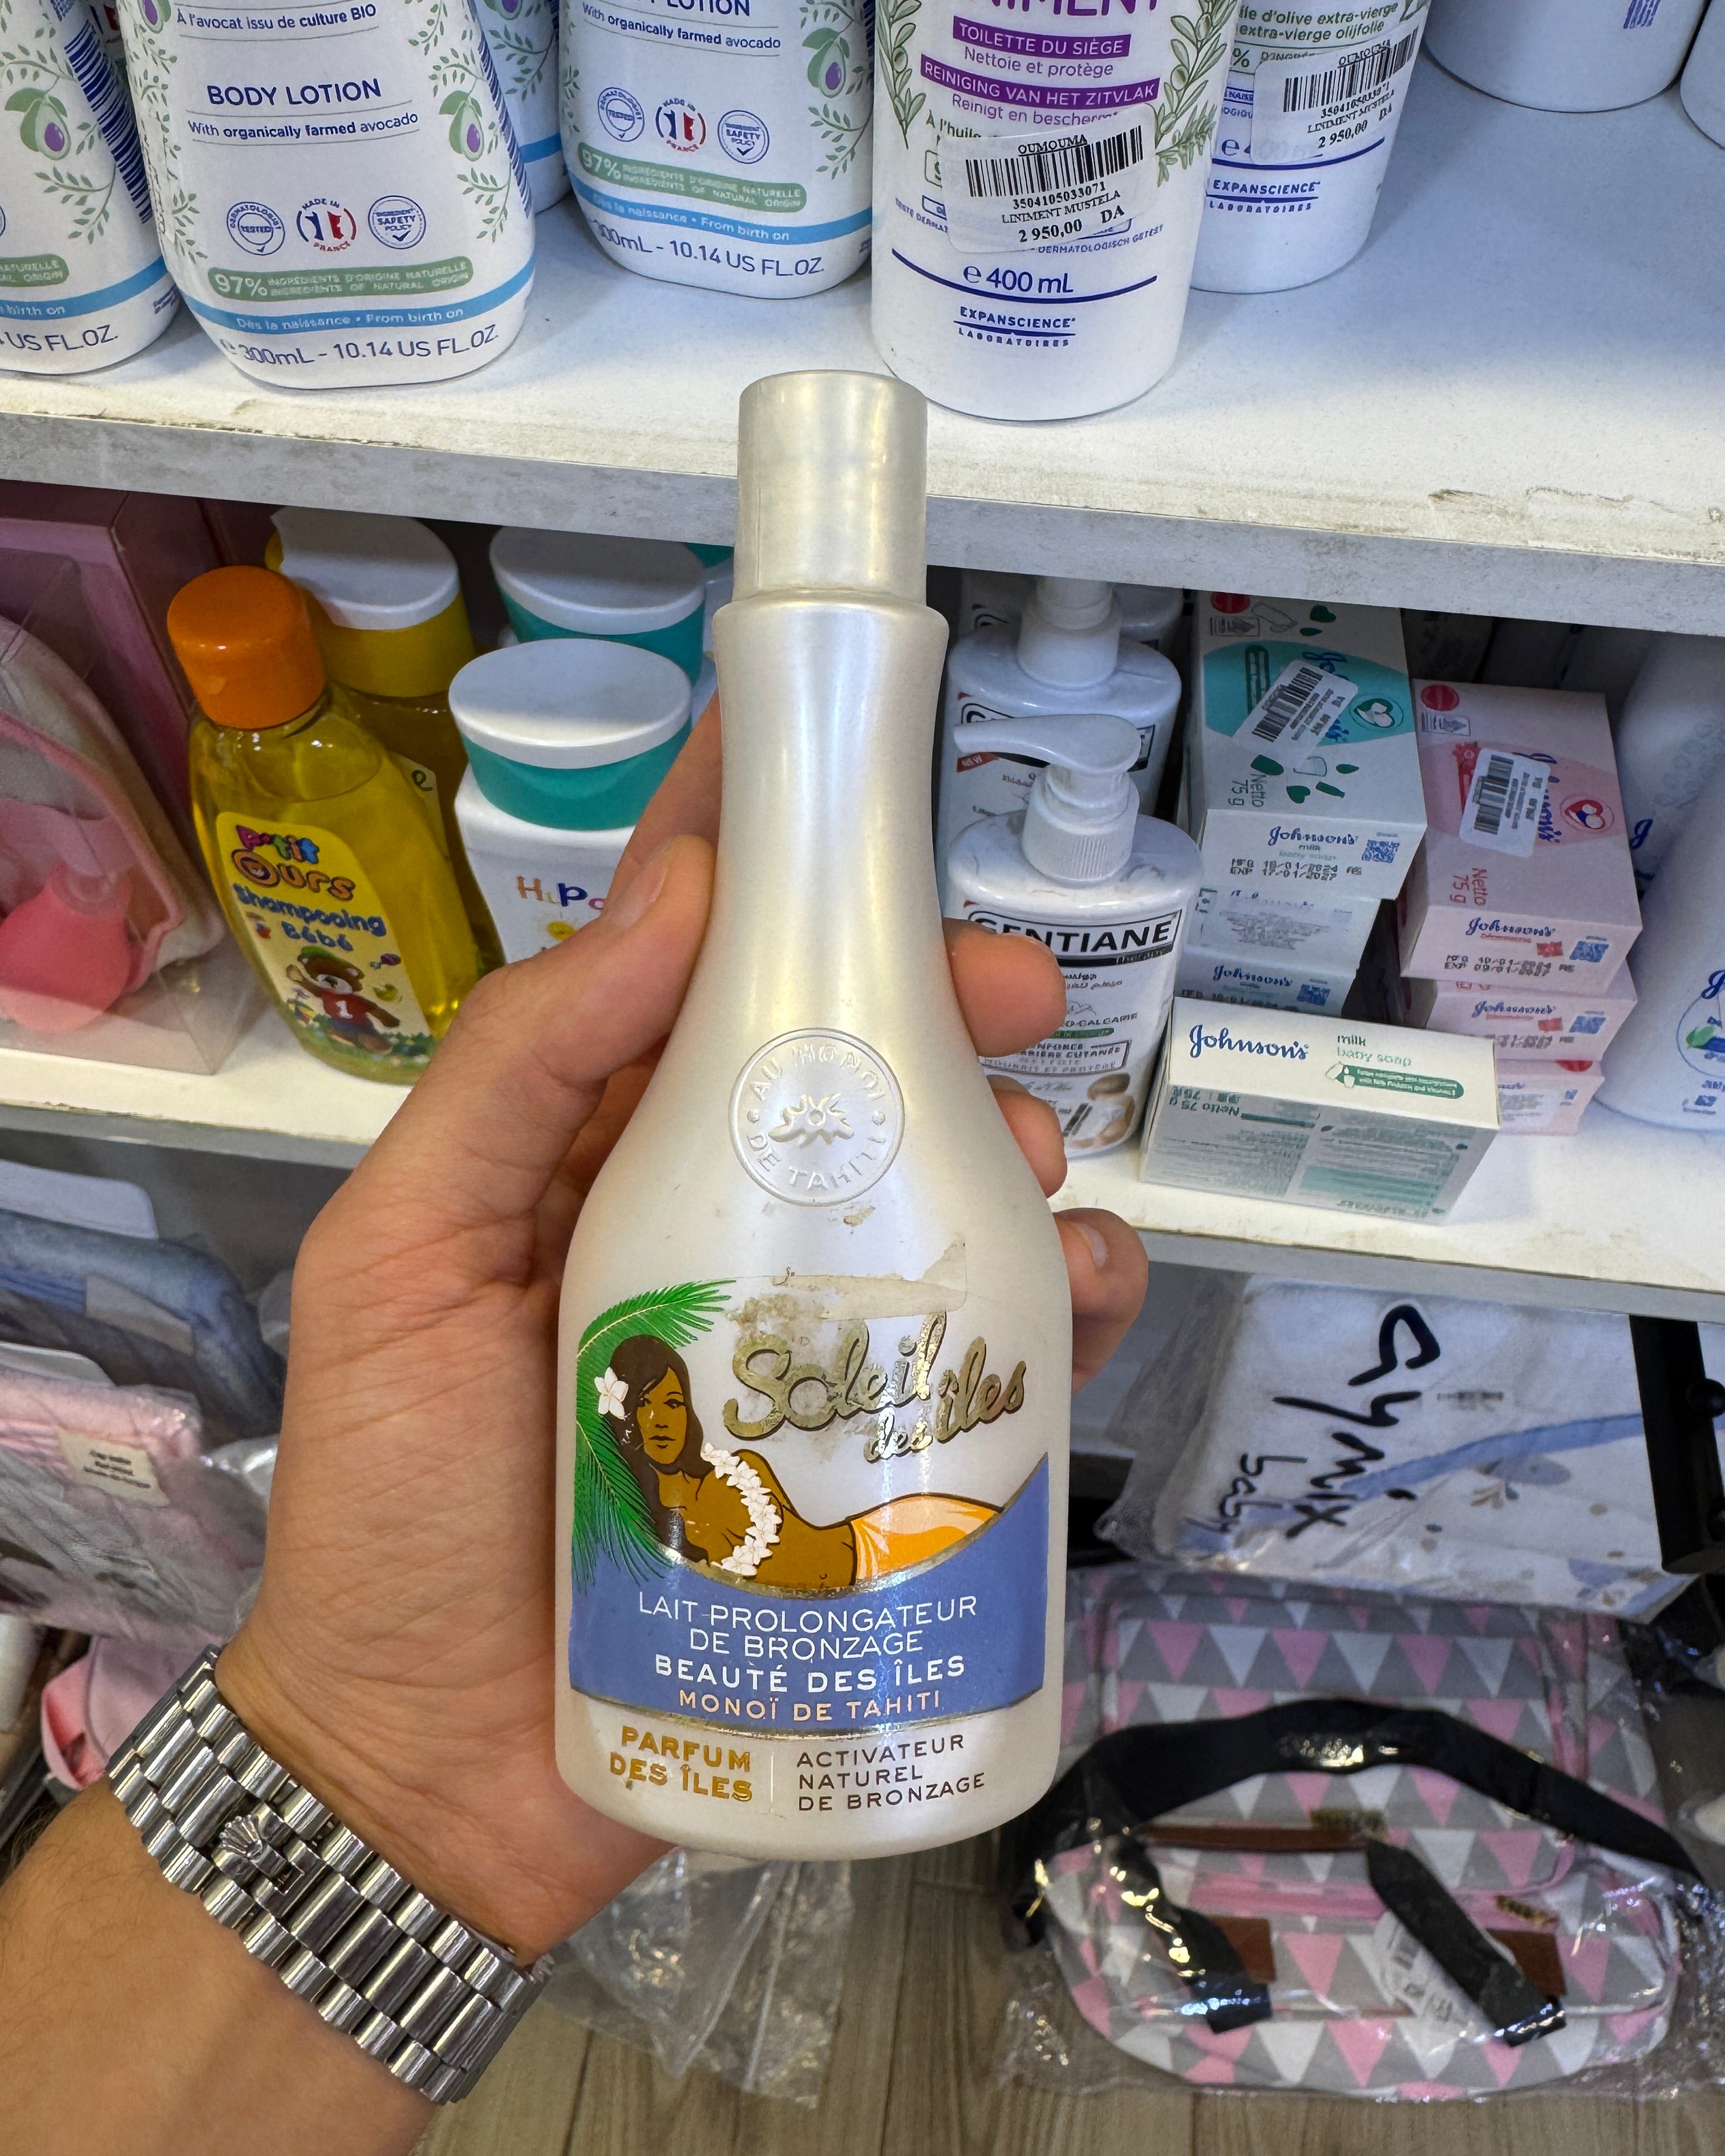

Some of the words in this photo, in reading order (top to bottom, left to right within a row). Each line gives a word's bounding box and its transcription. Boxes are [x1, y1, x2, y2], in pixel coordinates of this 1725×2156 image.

[247, 15, 273, 30] issu
[277, 15, 295, 29] de
[299, 11, 348, 27] culture
[350, 3, 376, 21] BIO
[582, 2, 605, 21] With
[608, 14, 674, 39] organically
[678, 28, 722, 45] farmed
[726, 37, 781, 48] avocado
[1262, 9, 1312, 25] d'olive
[1317, 2, 1398, 25] extra-vierge
[959, 22, 1036, 52] TOILETTE
[1042, 40, 1067, 54] DU
[1072, 38, 1124, 55] SIÈGE
[1336, 21, 1384, 39] olijfolie
[965, 46, 1021, 72] Nettoie
[1026, 62, 1043, 74] et
[1048, 62, 1113, 79] protège
[207, 85, 277, 106] BODY
[286, 78, 382, 105] LOTION
[925, 61, 1001, 98] REINIGING
[1005, 86, 1040, 104] VAN
[1046, 92, 1080, 106] HET
[1086, 83, 1156, 106] ZITVLAK
[952, 93, 1003, 120] Reinigt
[1009, 110, 1027, 123] en
[188, 120, 219, 136] With
[224, 124, 301, 140] organically
[305, 121, 357, 136] farmed
[360, 112, 418, 133] avocado
[1018, 134, 1088, 155] OUMOUMA
[1013, 181, 1107, 210] 3504105033071
[1213, 180, 1317, 194] EXPANSCIENCE
[1002, 207, 1062, 224] LINIMENT
[1064, 190, 1121, 214] MUSTELA
[701, 217, 734, 233] From
[772, 230, 790, 241] on
[1019, 229, 1027, 242] 2
[1031, 218, 1083, 241] 950,00
[1100, 205, 1125, 224] DA
[670, 240, 721, 264] 10.14
[726, 250, 755, 274] US
[214, 273, 268, 298] 97%
[986, 268, 1033, 292] 400
[1038, 273, 1074, 293] mL
[46, 306, 66, 315] on
[366, 314, 404, 325] From
[447, 309, 464, 319] on
[960, 306, 1071, 328] EXPANSCIENCE
[4, 331, 42, 351] US
[333, 341, 392, 360] 10.14
[398, 340, 431, 357] US
[231, 848, 356, 901] Ours
[233, 882, 387, 937] Shampooing
[1189, 1024, 1307, 1060] Johnson's
[746, 1132, 781, 1172] DE
[723, 1311, 947, 1440] Soleil
[864, 1405, 933, 1463] des
[639, 1591, 698, 1622] LAIT
[711, 1595, 977, 1634] PROLONGATEUR
[690, 1628, 730, 1654] DE
[744, 1630, 924, 1660] BRONZAGE
[655, 1654, 788, 1693] BEAUTÉ
[808, 1669, 877, 1693] DES
[894, 1655, 965, 1686] ÎLES
[679, 1689, 778, 1720] MONOÏ
[793, 1702, 833, 1721] DE
[846, 1689, 940, 1719] TAHITI
[622, 1725, 751, 1773] PARFUM
[797, 1734, 964, 1768] ACTIVATEUR
[610, 1752, 668, 1786] DES
[680, 1764, 752, 1802] ÎLES
[799, 1765, 923, 1790] NATUREL
[799, 1796, 832, 1811] DE
[848, 1772, 985, 1809] BRONZAGE
